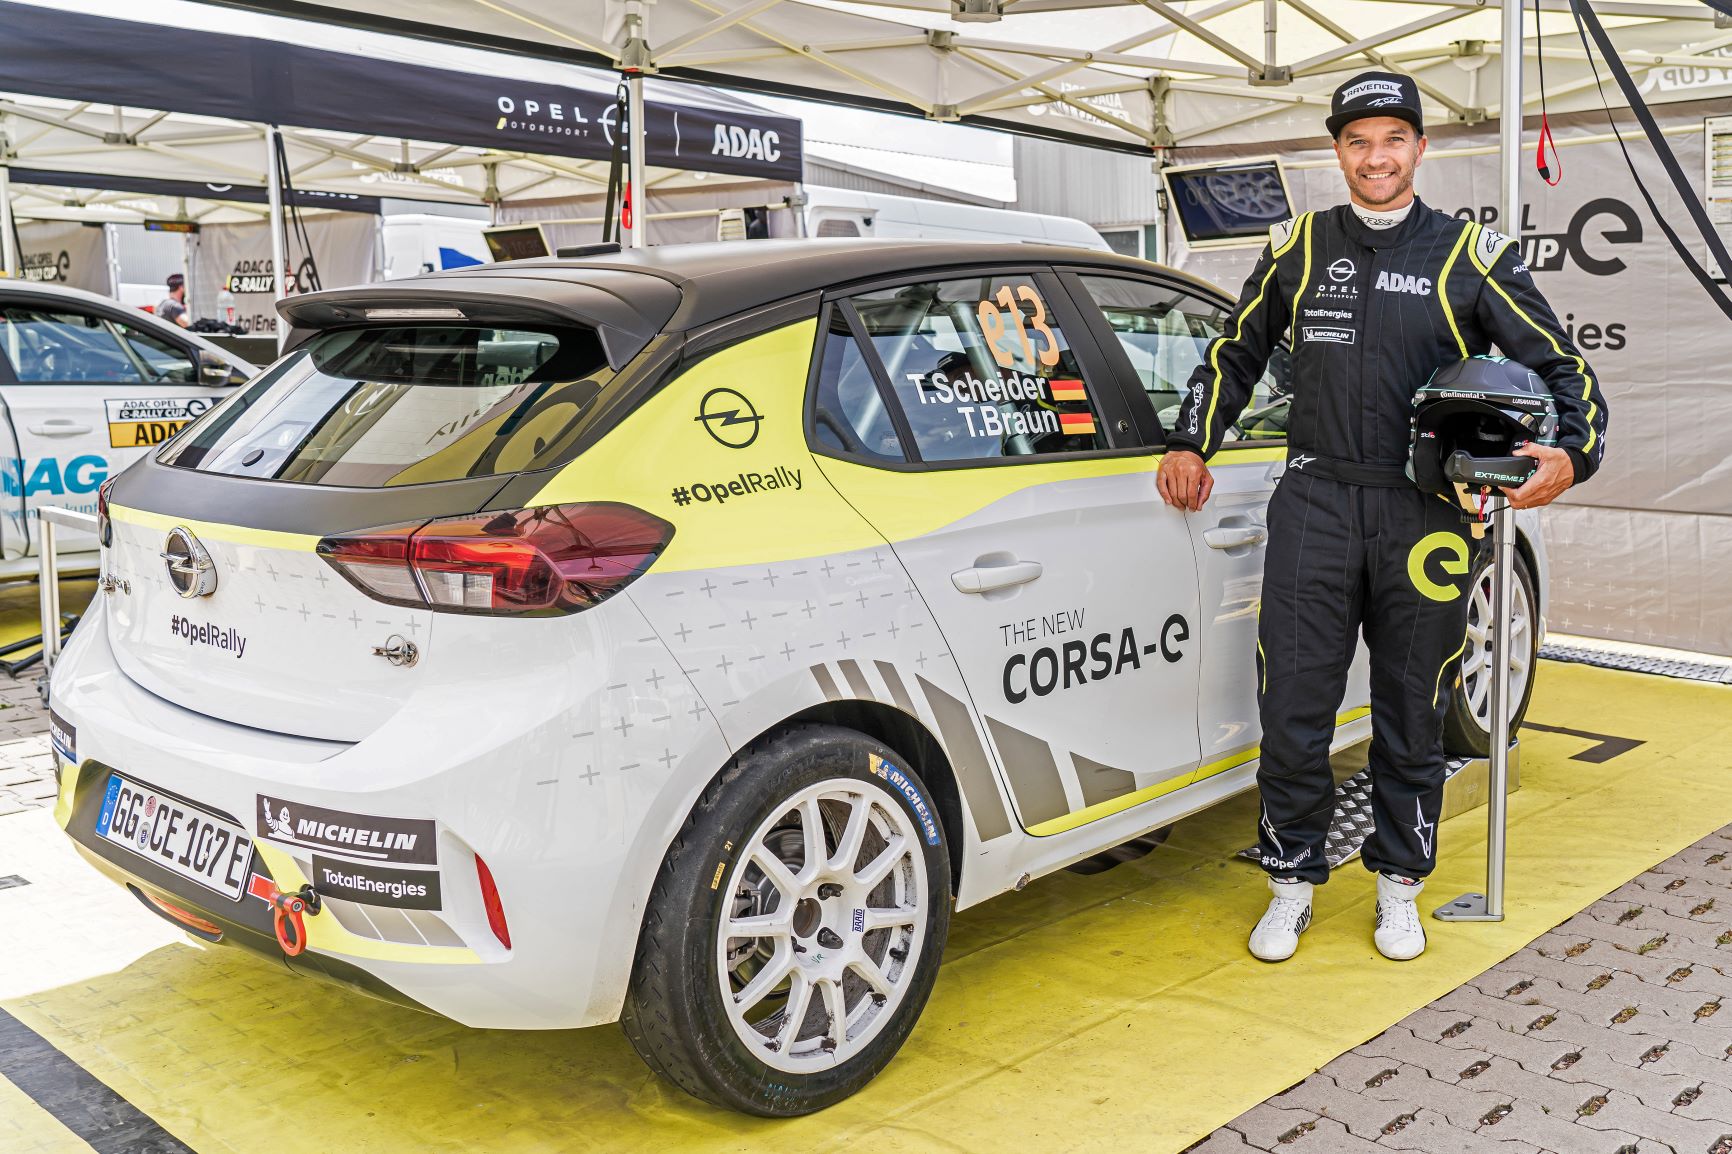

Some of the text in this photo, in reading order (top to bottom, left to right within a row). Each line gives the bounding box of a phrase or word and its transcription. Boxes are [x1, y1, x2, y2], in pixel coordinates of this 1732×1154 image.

[1347, 83, 1396, 97] RAVENOL
[497, 97, 589, 123] OPEL
[712, 123, 781, 162] ADAC
[235, 260, 263, 273] ADAC
[1319, 285, 1358, 294] OPEL
[1375, 271, 1432, 295] ADAC
[979, 285, 1060, 366] e13
[1304, 309, 1353, 319] TotalEnergies
[1314, 330, 1350, 339] MICHELIN
[906, 372, 1047, 405] T.Scheider
[1440, 391, 1480, 399] Continental
[120, 408, 164, 419] e-RALLY
[165, 407, 186, 418] CUP
[123, 400, 151, 409] ADAC
[134, 421, 191, 445] ADA
[957, 405, 1060, 438] T.Braun
[671, 465, 803, 507] #OpelRally
[171, 614, 247, 659] #OpelRally
[1000, 607, 1085, 647] THE NEW
[1002, 613, 1190, 705] CORSA-e
[890, 770, 936, 839] MICHELIN
[101, 812, 109, 826] D
[111, 787, 145, 841] GG
[150, 803, 184, 860] CE
[296, 818, 418, 851] MICHELIN
[322, 867, 428, 899] TotalEnergies
[854, 908, 863, 933] BRAID
